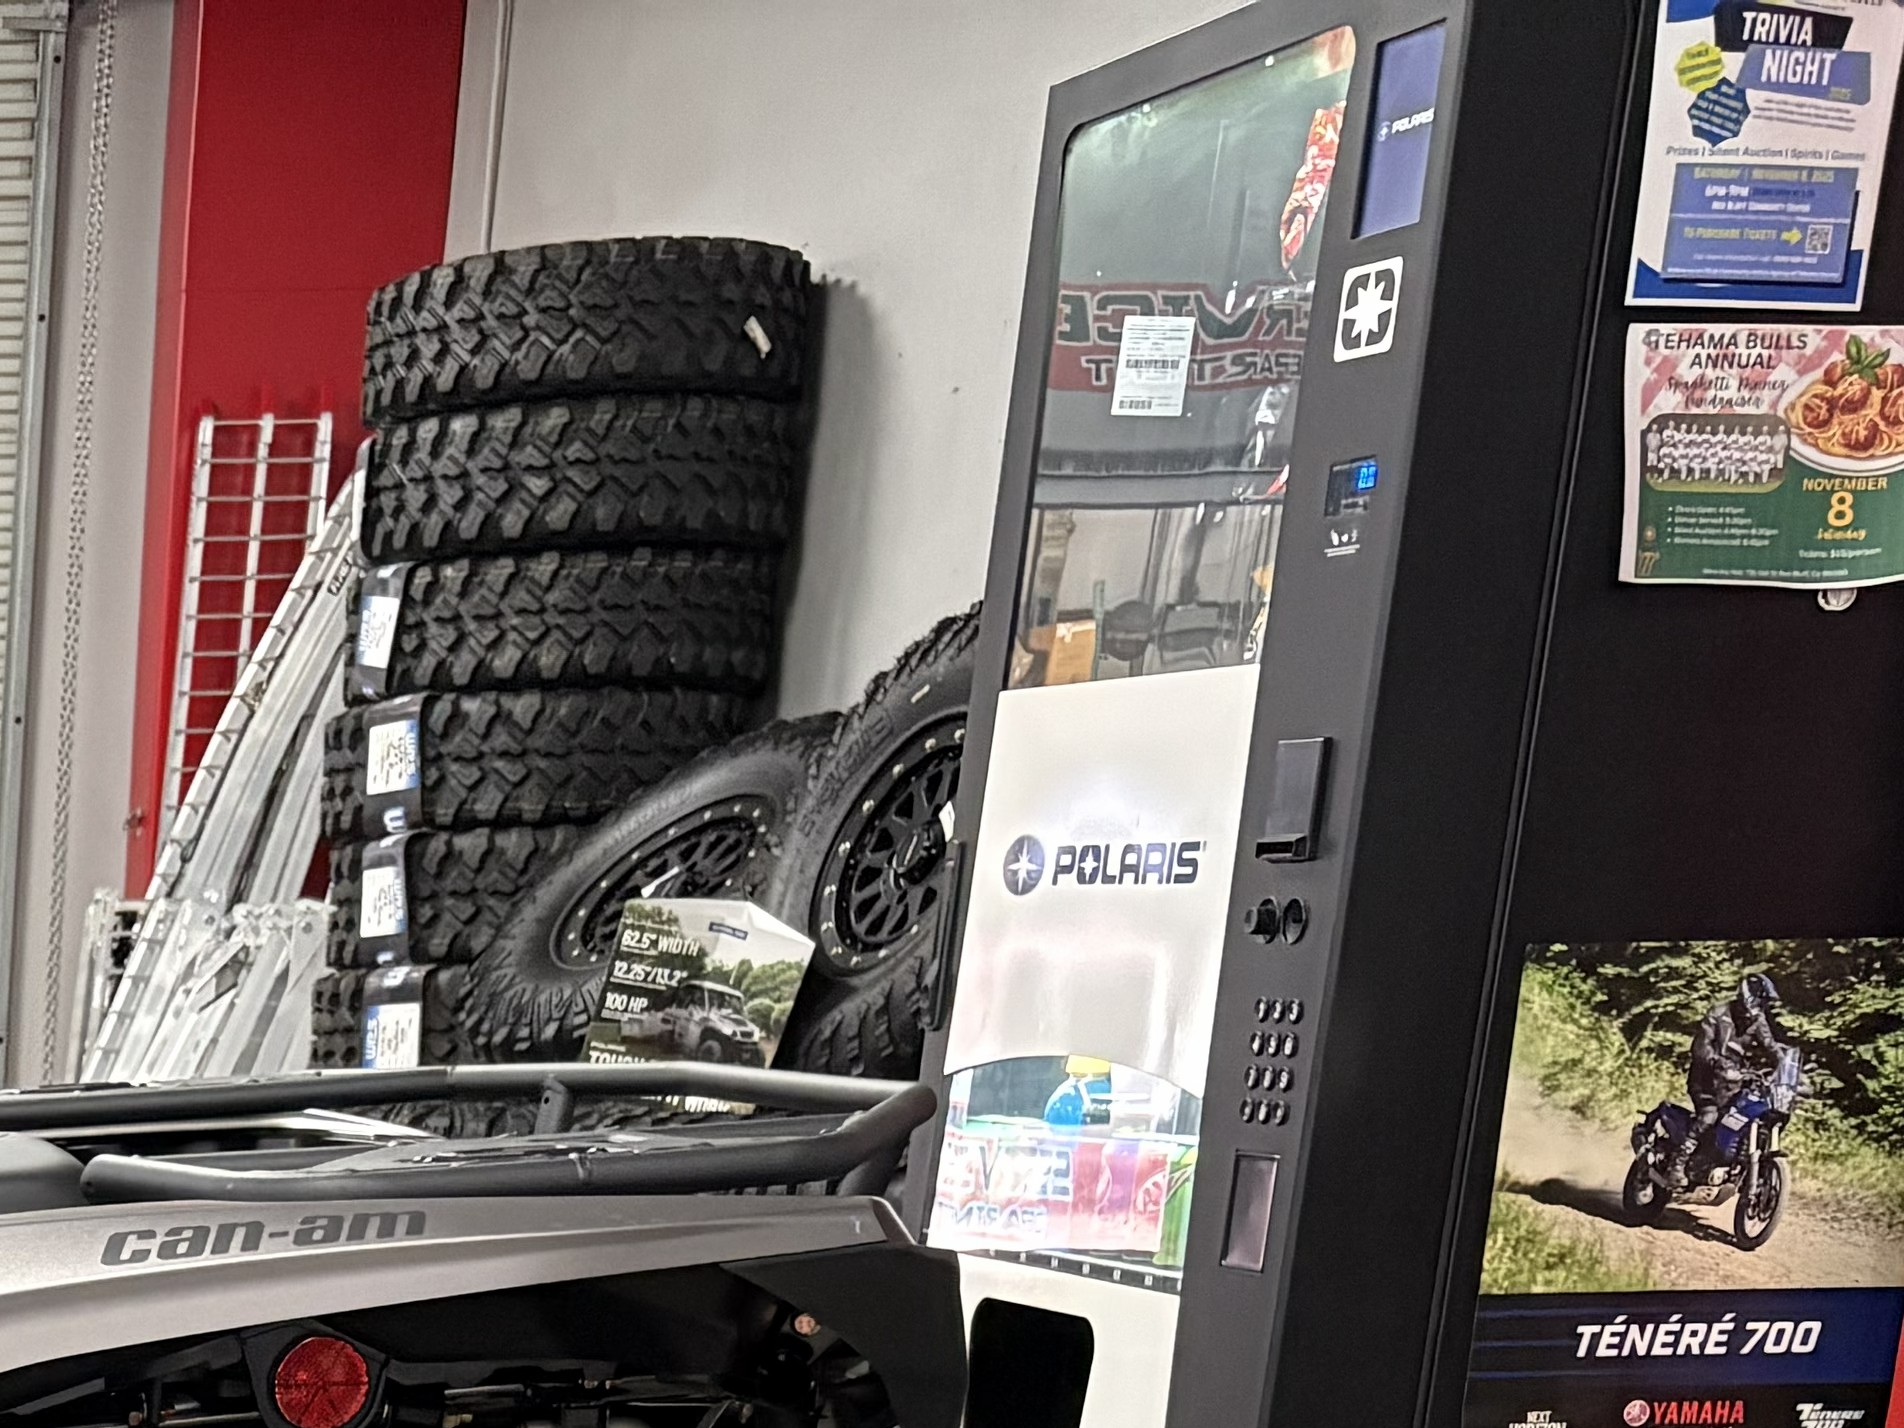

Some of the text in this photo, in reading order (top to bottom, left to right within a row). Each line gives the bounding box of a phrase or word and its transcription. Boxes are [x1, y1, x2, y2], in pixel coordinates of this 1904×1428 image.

[1742, 11, 1814, 46] TRIVIA
[1761, 49, 1837, 86] NIGHT
[1652, 332, 1809, 350] TEHAMA BULLS
[1690, 352, 1776, 370] ANNUAL
[1802, 477, 1888, 491] NOVEMBER
[1827, 491, 1855, 527] 8
[1051, 840, 1200, 888] POLARIS
[658, 934, 700, 957] WIDTH
[628, 997, 648, 1014] HP
[99, 1208, 427, 1267] can-am
[1575, 1312, 1822, 1358] TÉNÉRÉ 700
[1653, 1400, 1745, 1426] YAMAHA
